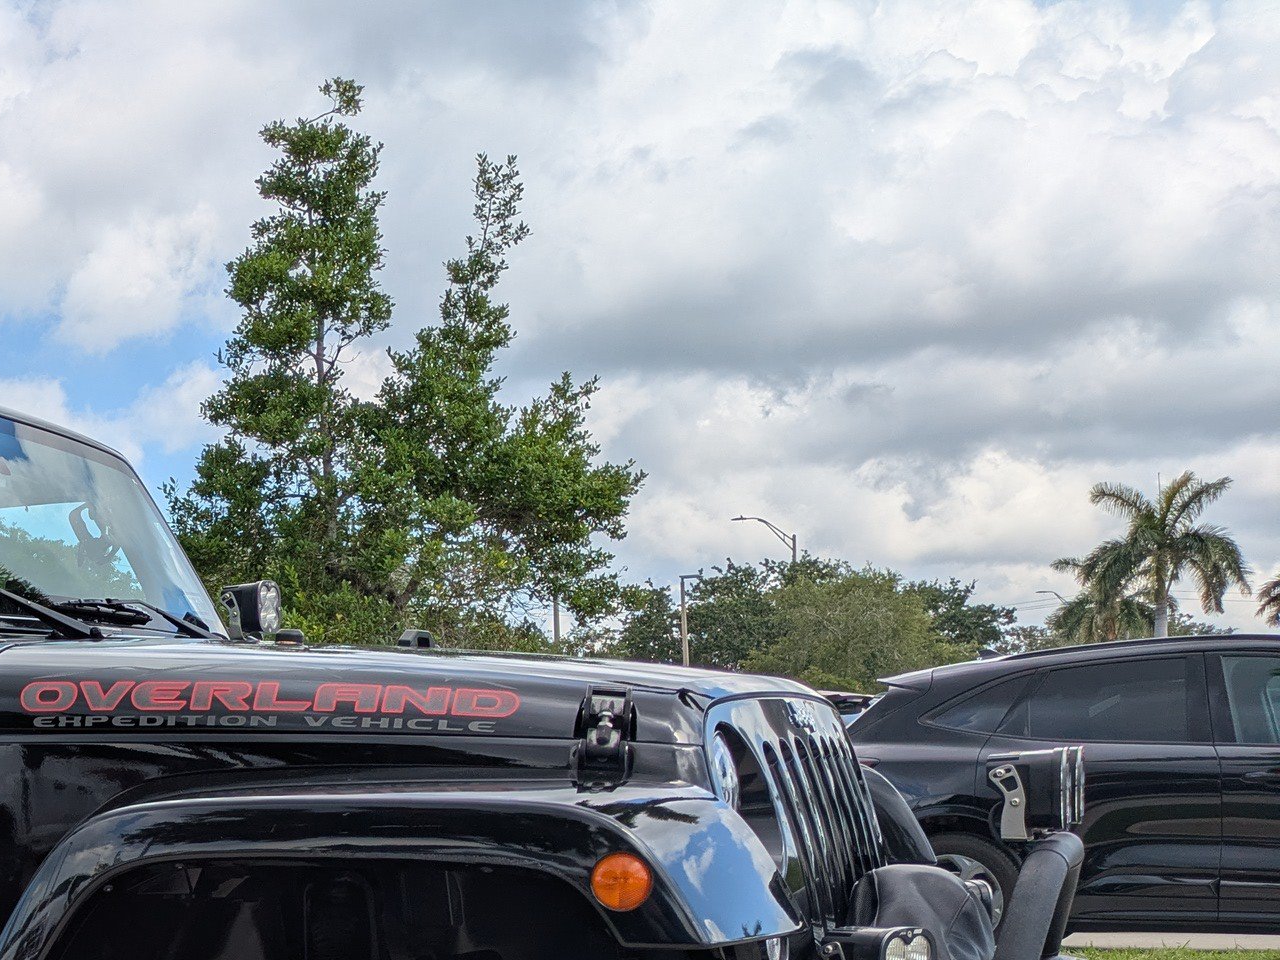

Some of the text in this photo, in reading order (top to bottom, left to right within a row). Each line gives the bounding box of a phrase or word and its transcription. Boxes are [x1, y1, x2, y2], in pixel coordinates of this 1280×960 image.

[20, 681, 521, 718] OVERLAND
[33, 715, 497, 733] EXPEDITION VEHICLE
